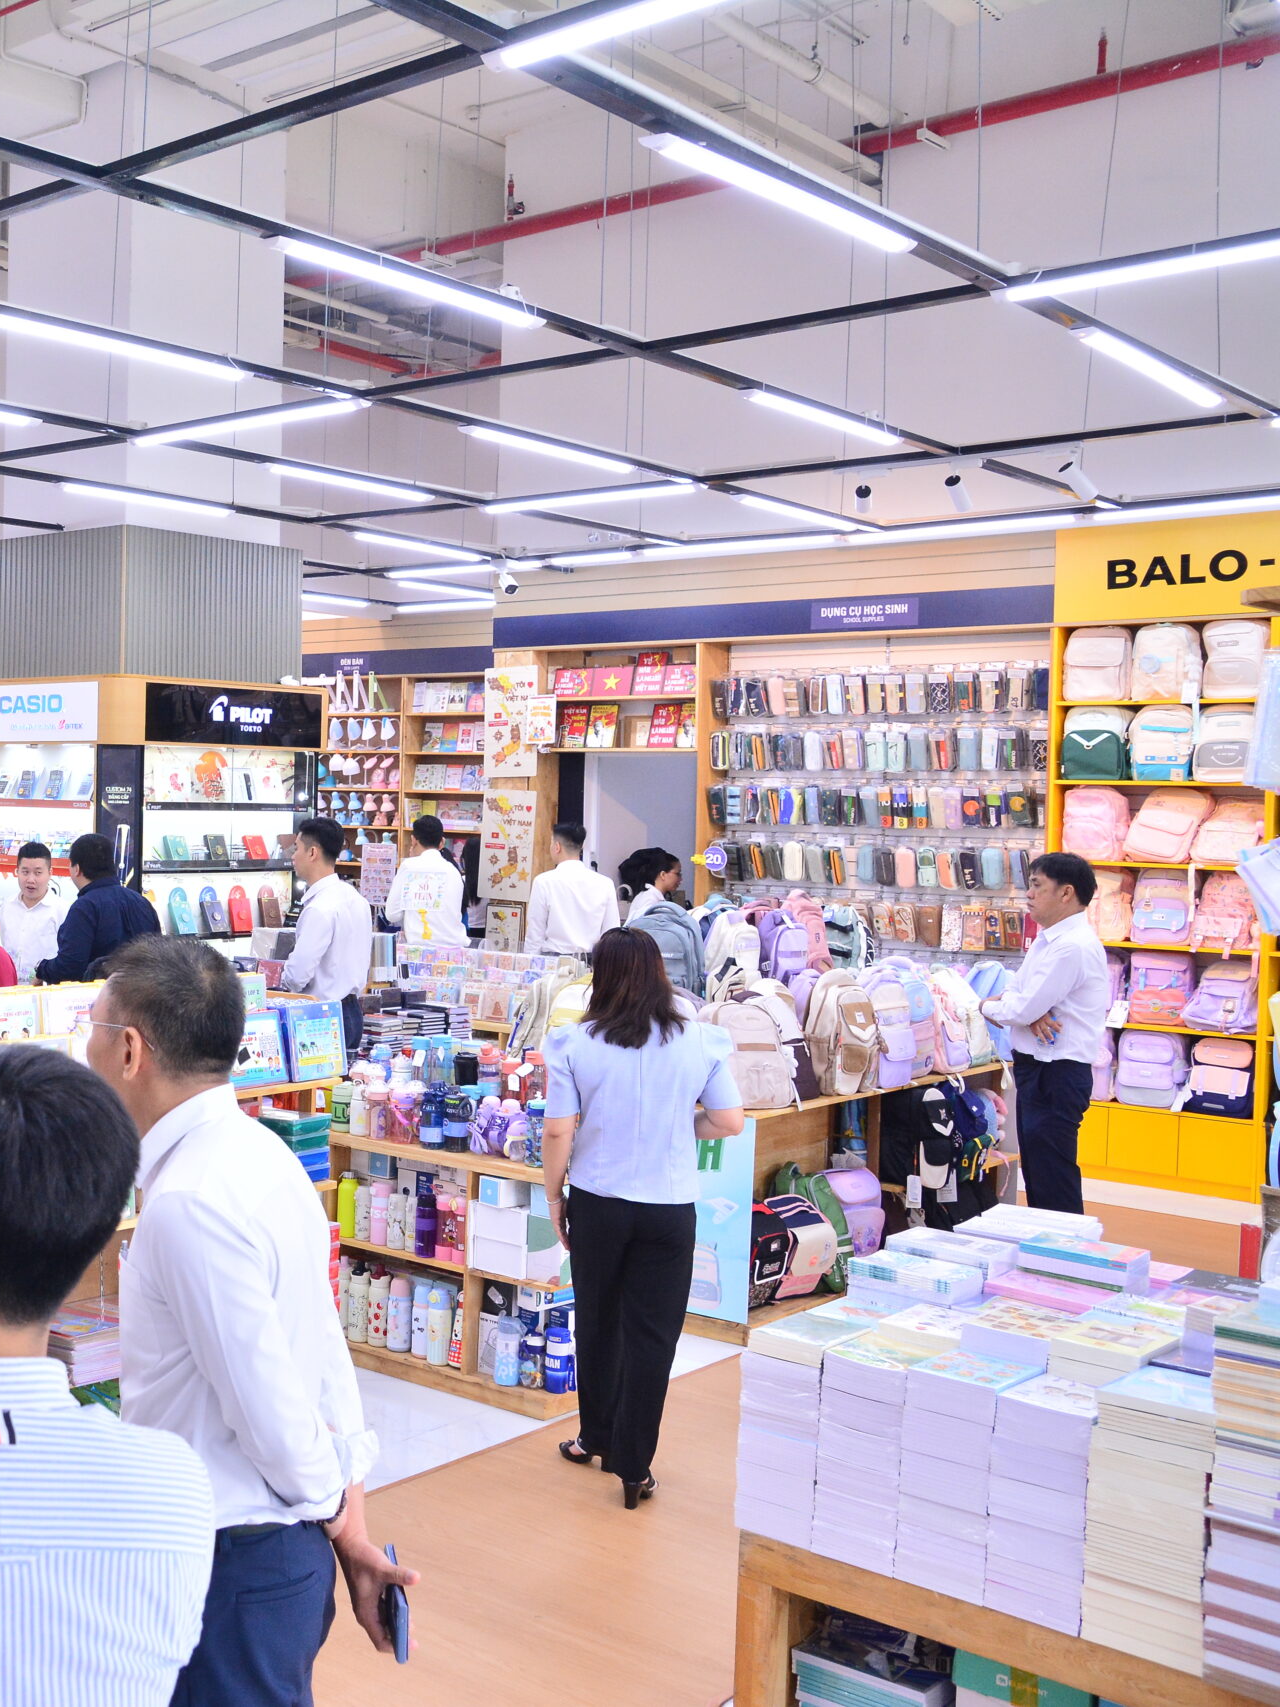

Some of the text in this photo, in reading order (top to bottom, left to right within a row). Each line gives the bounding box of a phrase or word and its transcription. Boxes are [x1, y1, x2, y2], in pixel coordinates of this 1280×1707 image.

[1106, 550, 1248, 590] BALO
[821, 603, 908, 618] DỤNG CỤ HỌC SINH
[0, 694, 63, 714] CASIO
[229, 706, 273, 724] PILOT
[240, 724, 262, 733] TOKYO
